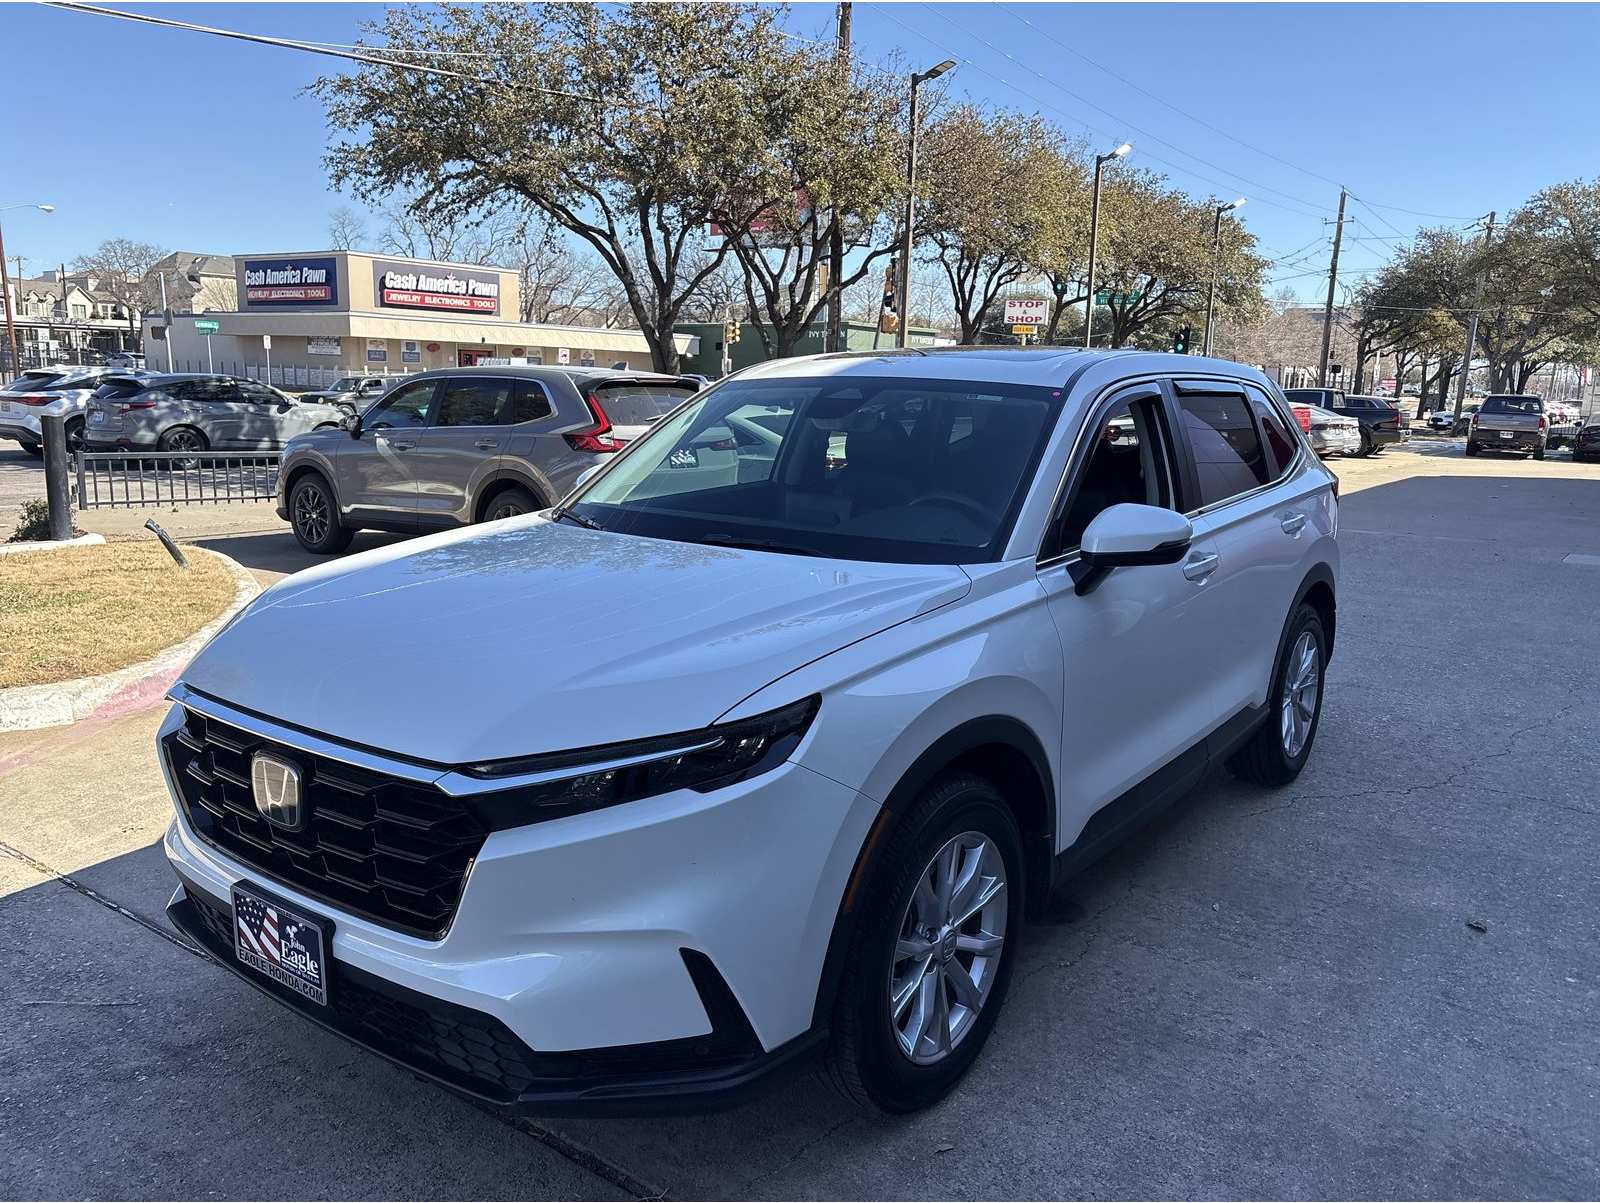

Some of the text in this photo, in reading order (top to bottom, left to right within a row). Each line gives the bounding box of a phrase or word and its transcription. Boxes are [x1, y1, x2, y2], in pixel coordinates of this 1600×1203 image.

[245, 267, 326, 286] Cash America Pawn
[385, 271, 498, 297] Cash America Pawn
[271, 289, 305, 298] ELECTRONICS
[308, 288, 326, 298] TOOLS
[388, 292, 496, 308] JEWELRY ELECTRONICS TOOLS
[1008, 300, 1044, 309] STOP
[1007, 315, 1042, 323] SHOP
[290, 938, 306, 953] John
[280, 939, 319, 974] Eagle
